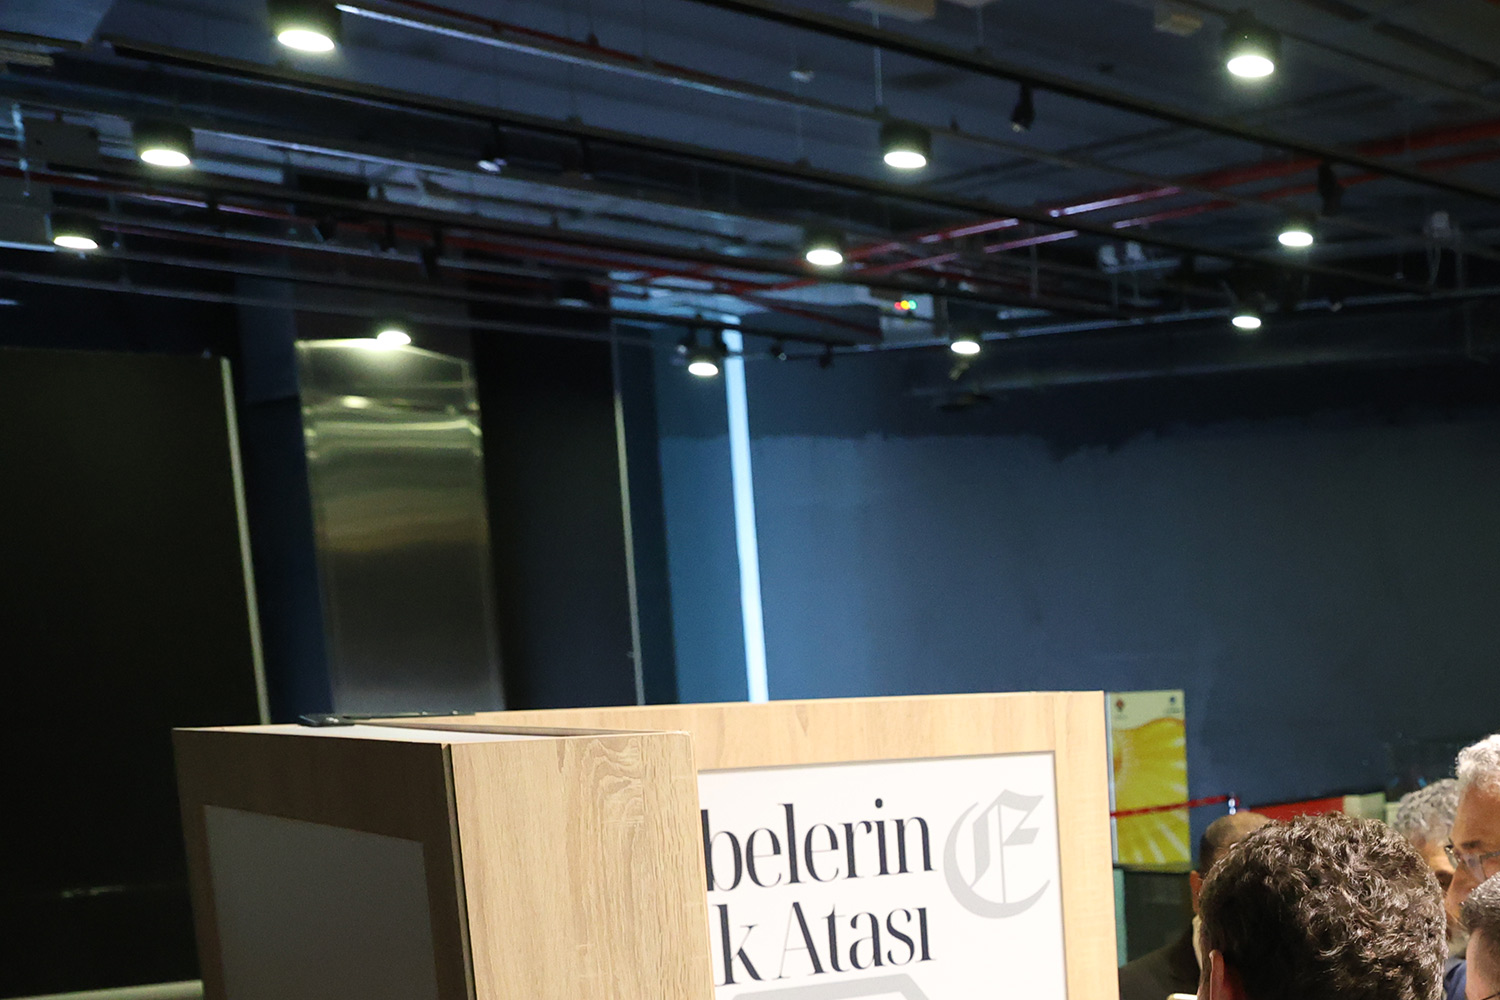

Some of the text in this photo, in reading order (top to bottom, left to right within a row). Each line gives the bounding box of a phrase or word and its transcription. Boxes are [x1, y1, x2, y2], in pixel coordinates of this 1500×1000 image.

[700, 798, 937, 892] belerin
[712, 901, 937, 987] k Atası
